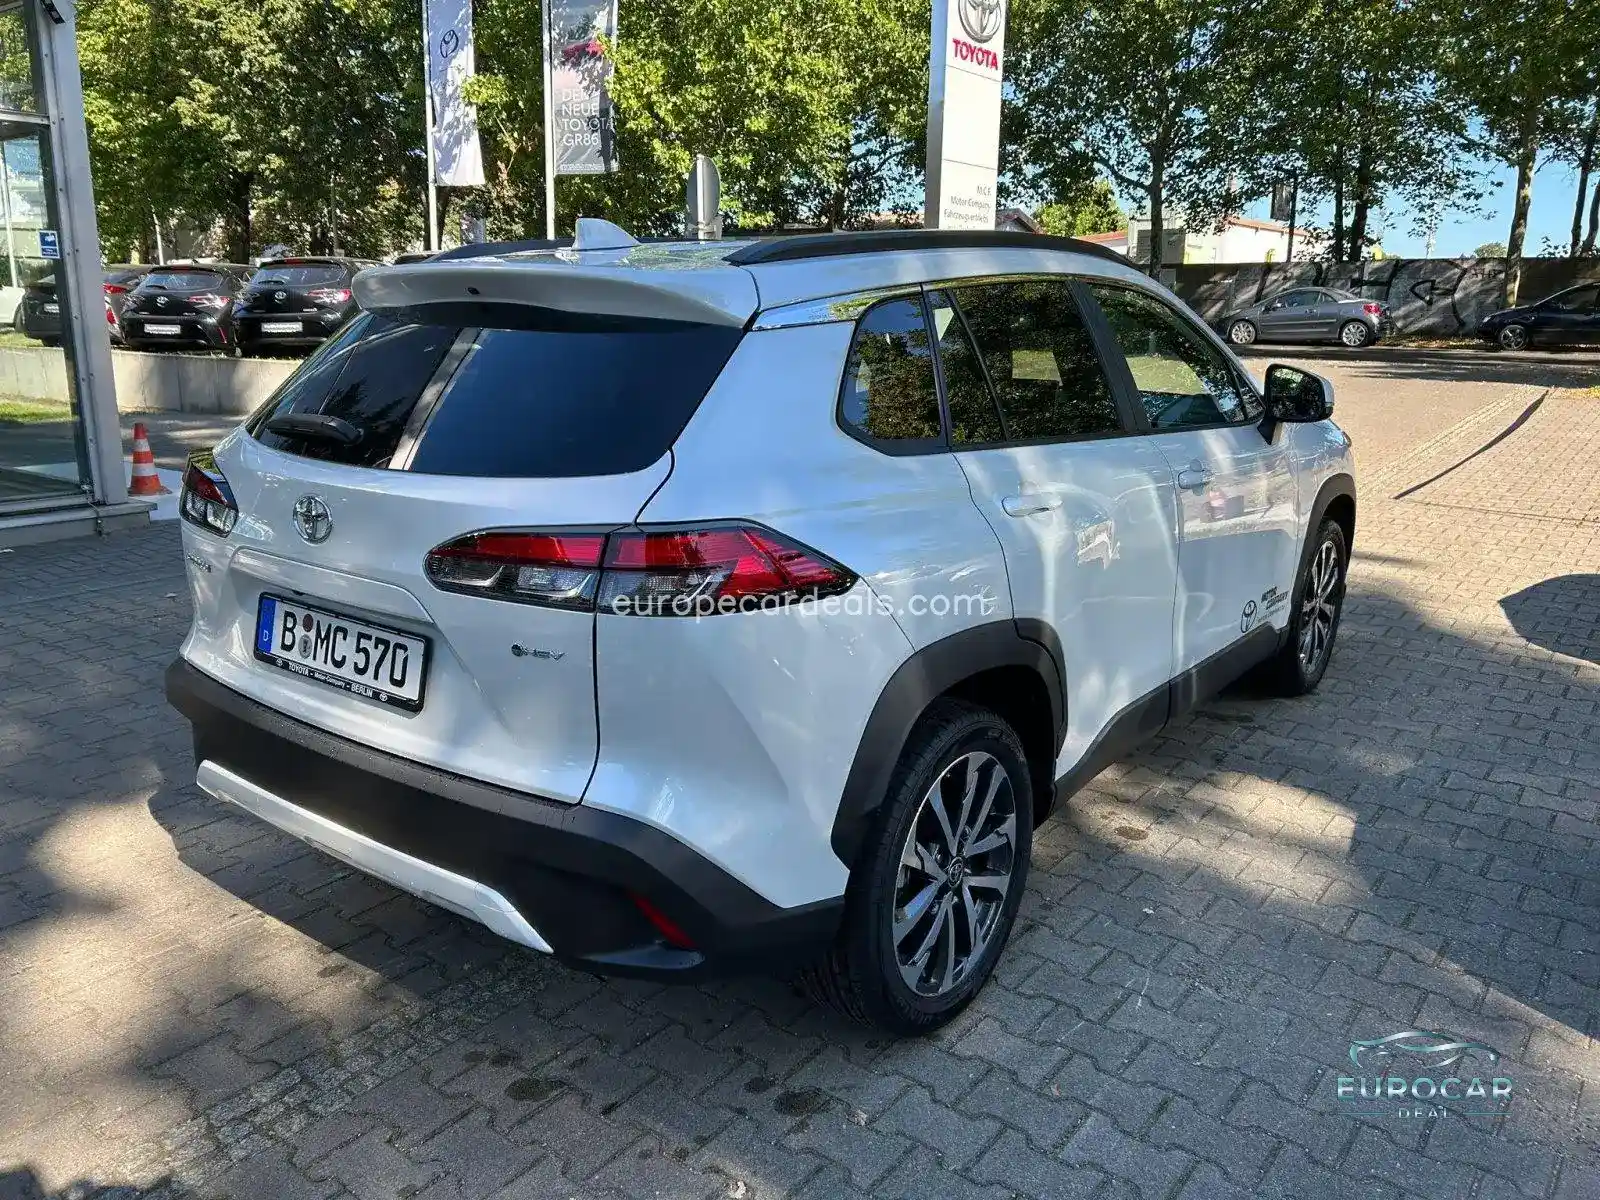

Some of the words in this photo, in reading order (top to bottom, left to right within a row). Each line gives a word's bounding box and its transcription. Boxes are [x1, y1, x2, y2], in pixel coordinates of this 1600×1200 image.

[953, 38, 998, 70] TOYOTA
[562, 103, 600, 116] NEUE
[561, 118, 613, 131] TOYOTA
[562, 133, 600, 146] GR86
[262, 629, 270, 642] D
[280, 610, 297, 652] B
[312, 619, 349, 669] MC
[353, 631, 409, 689] 570
[288, 661, 309, 677] TOYOTA
[351, 682, 373, 698] BERLIN
